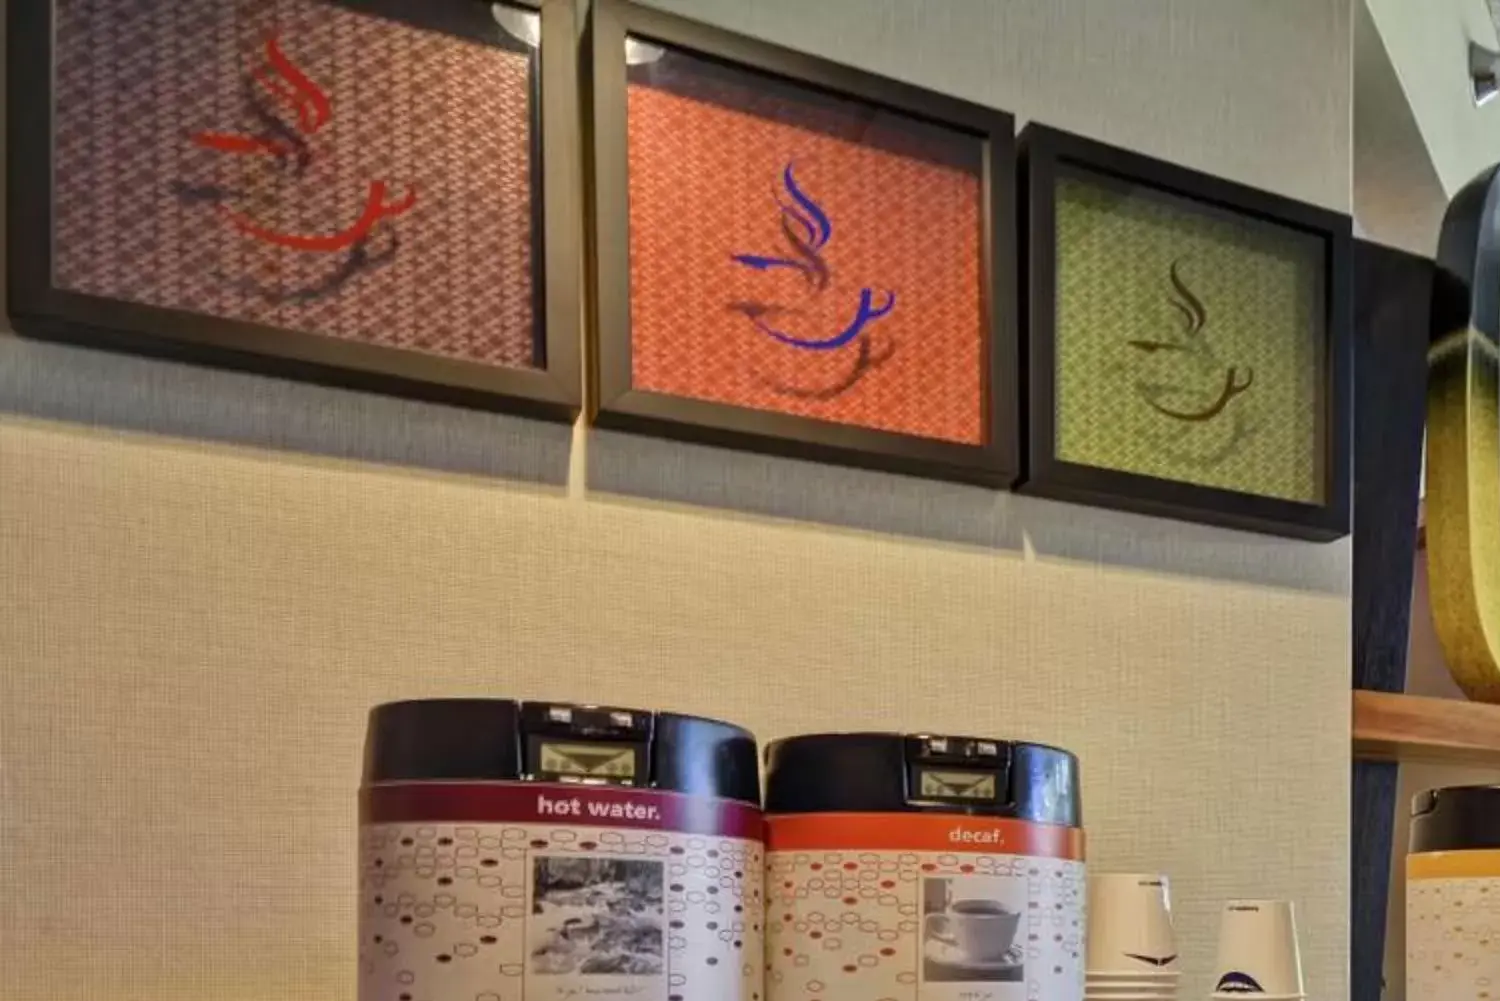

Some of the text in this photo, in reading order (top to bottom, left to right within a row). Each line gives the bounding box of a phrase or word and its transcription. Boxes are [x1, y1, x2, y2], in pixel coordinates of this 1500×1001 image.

[537, 794, 661, 820] hot water.
[949, 825, 1005, 845] decaf.
